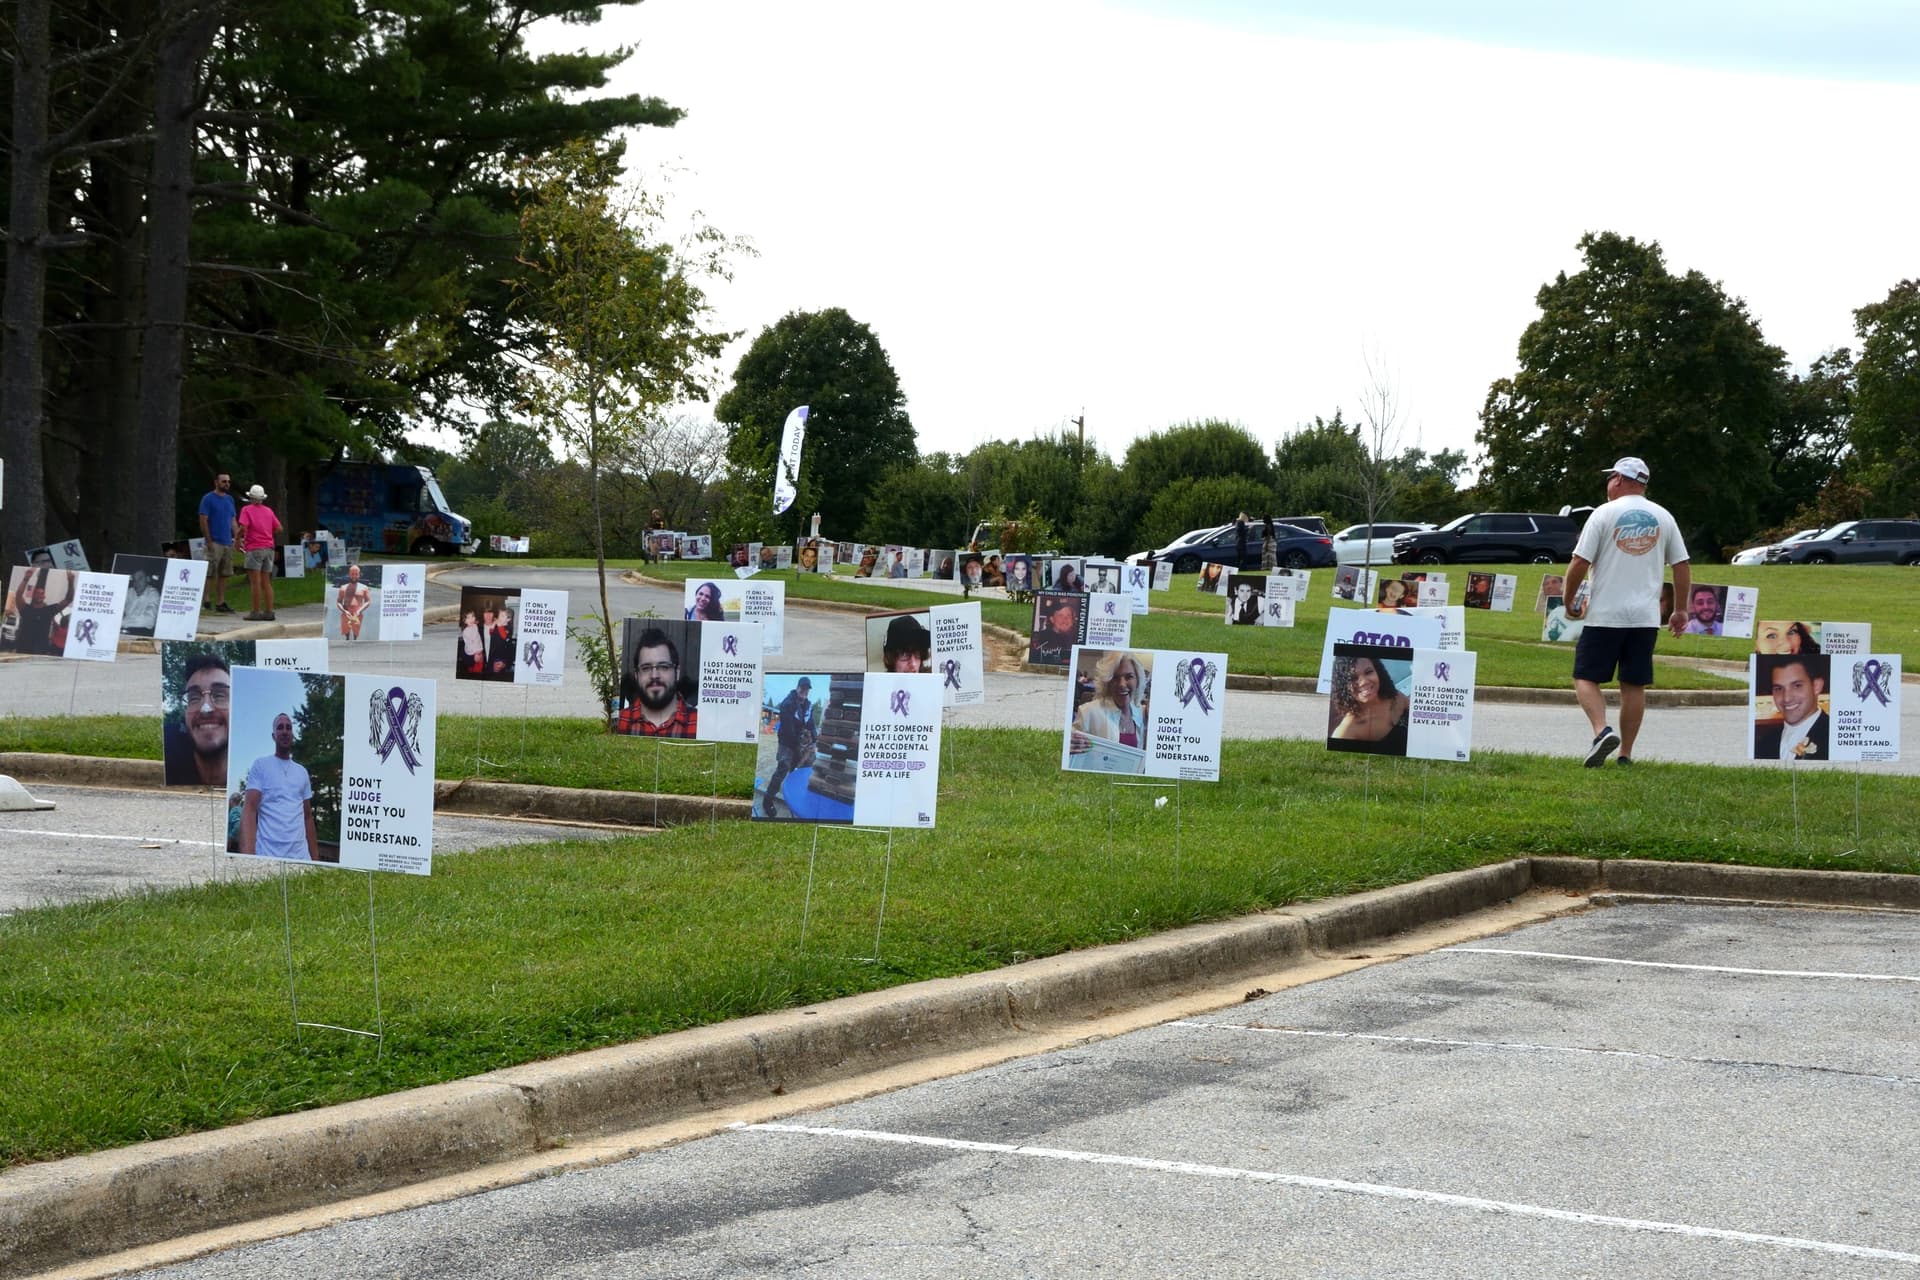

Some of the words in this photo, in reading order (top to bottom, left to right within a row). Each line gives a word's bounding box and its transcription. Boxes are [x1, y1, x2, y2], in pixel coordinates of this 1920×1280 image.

[792, 426, 800, 456] TODAY
[1081, 598, 1087, 607] BY
[1078, 609, 1086, 643] FENTANYL
[1156, 752, 1212, 762] UNDERSTAND.
[862, 760, 905, 770] STAND
[907, 761, 926, 770] UP
[349, 777, 382, 788] DON'T
[348, 791, 381, 802] JUDGE
[348, 804, 379, 815] WHAT
[383, 806, 405, 818] YOU
[348, 817, 380, 829] DON'T
[347, 831, 421, 846] UNDERSTAND.
